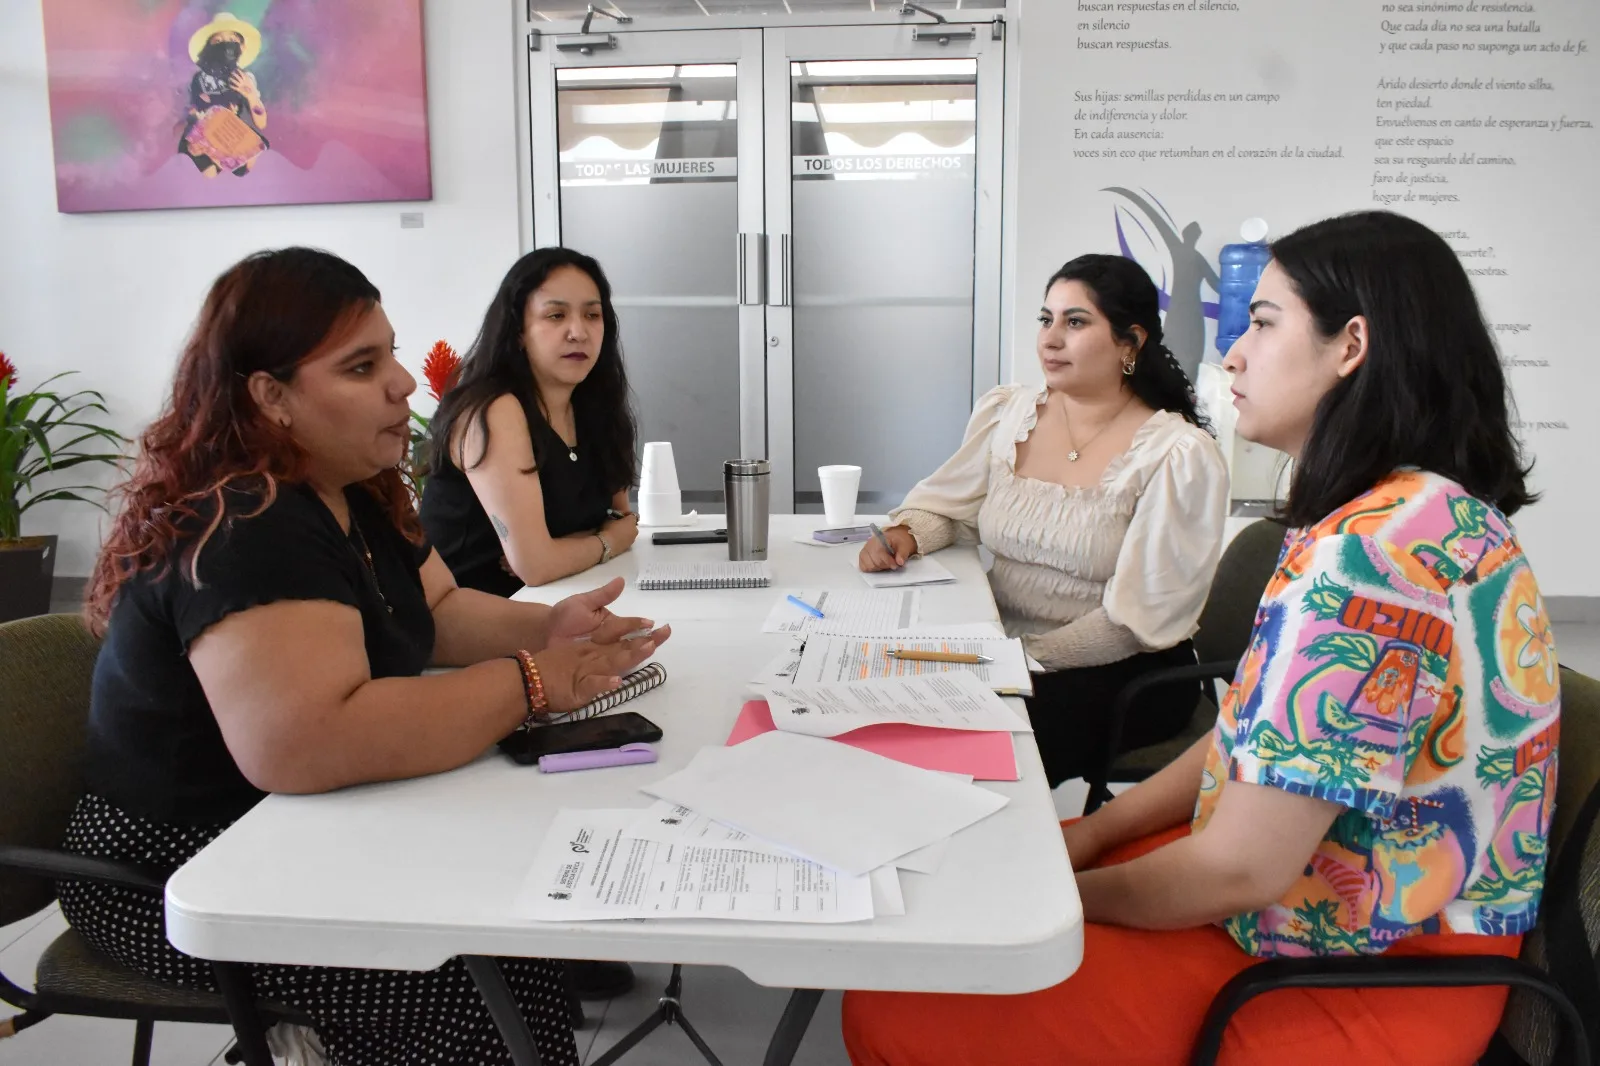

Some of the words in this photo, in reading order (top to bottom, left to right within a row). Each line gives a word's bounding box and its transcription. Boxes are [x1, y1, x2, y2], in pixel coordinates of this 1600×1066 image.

[1077, 0, 1114, 11] buscan
[1117, 2, 1170, 14] respuestas
[1172, 3, 1184, 11] en
[1187, 0, 1196, 11] el
[1199, 0, 1240, 12] silencio,
[1382, 4, 1395, 12] no
[1397, 4, 1414, 12] sea
[1416, 1, 1464, 12] sinónimo
[1466, 1, 1478, 12] de
[1481, 2, 1536, 13] resistencia.
[1077, 20, 1090, 30] en
[1092, 16, 1130, 30] silencio
[1381, 20, 1402, 34] Que
[1404, 20, 1428, 32] cada
[1431, 20, 1447, 32] día
[1450, 24, 1463, 32] no
[1466, 24, 1481, 32] sea
[1484, 24, 1504, 33] una
[1506, 20, 1540, 33] batalla
[1077, 37, 1112, 49] buscan
[1116, 39, 1172, 52] respuestas.
[1379, 42, 1387, 54] y
[1388, 42, 1407, 54] que
[1409, 38, 1433, 51] cada
[1436, 42, 1460, 54] paso
[1462, 43, 1475, 51] no
[1478, 42, 1520, 55] suponga
[1523, 44, 1536, 52] un
[1539, 42, 1560, 53] acto
[1562, 40, 1575, 52] de
[1576, 41, 1588, 56] fe.
[1408, 78, 1448, 90] desierto
[1450, 78, 1483, 90] donde
[1485, 78, 1494, 90] el
[1496, 79, 1526, 90] viento
[1528, 78, 1554, 91] silba,
[1074, 90, 1092, 102] Sus
[1095, 90, 1122, 105] hijas:
[1124, 89, 1164, 102] semillas
[1167, 89, 1212, 104] perdidas
[1214, 93, 1226, 102] en
[1229, 93, 1243, 102] un
[1246, 92, 1280, 104] campo
[1376, 98, 1392, 108] ten
[1394, 97, 1432, 111] piedad.
[1074, 109, 1086, 120] de
[1089, 108, 1148, 124] indiferencia
[1150, 111, 1158, 124] y
[1160, 109, 1188, 121] dolor.
[1376, 115, 1438, 128] Envuélvenos
[1440, 119, 1452, 127] en
[1454, 117, 1482, 128] canto
[1484, 116, 1496, 128] de
[1499, 118, 1549, 131] esperanza
[1550, 119, 1558, 131] y
[1558, 116, 1594, 131] fuerza,
[1074, 128, 1088, 139] En
[1091, 127, 1114, 139] cada
[1117, 128, 1164, 140] ausencia:
[1374, 137, 1393, 149] que
[1396, 136, 1415, 146] este
[1417, 136, 1454, 149] espacio
[1073, 148, 1100, 158] voces
[1102, 147, 1118, 158] sin
[1120, 149, 1136, 158] eco
[1138, 149, 1156, 161] que
[1159, 147, 1210, 158] retumban
[1212, 149, 1224, 158] en
[1226, 147, 1236, 158] el
[1238, 148, 1278, 158] corazón
[1280, 147, 1292, 158] de
[1295, 147, 1304, 158] la
[1306, 147, 1345, 158] ciudad.
[1374, 156, 1390, 165] sea
[1392, 156, 1404, 165] su
[1406, 154, 1456, 168] resguardo
[1459, 153, 1475, 165] del
[1476, 154, 1516, 166] camino,
[575, 163, 620, 176] TOD
[625, 163, 650, 176] LAS
[653, 161, 715, 174] MUJERES
[804, 158, 852, 172] TODOS
[855, 157, 883, 171] LOS
[885, 156, 962, 170] DERECHOS
[1370, 171, 1394, 186] faro
[1396, 172, 1408, 183] de
[1408, 173, 1448, 186] justicia,
[1372, 190, 1402, 205] hogar
[1404, 190, 1416, 202] de
[1418, 192, 1460, 205] mujeres.
[1496, 323, 1532, 335] apague
